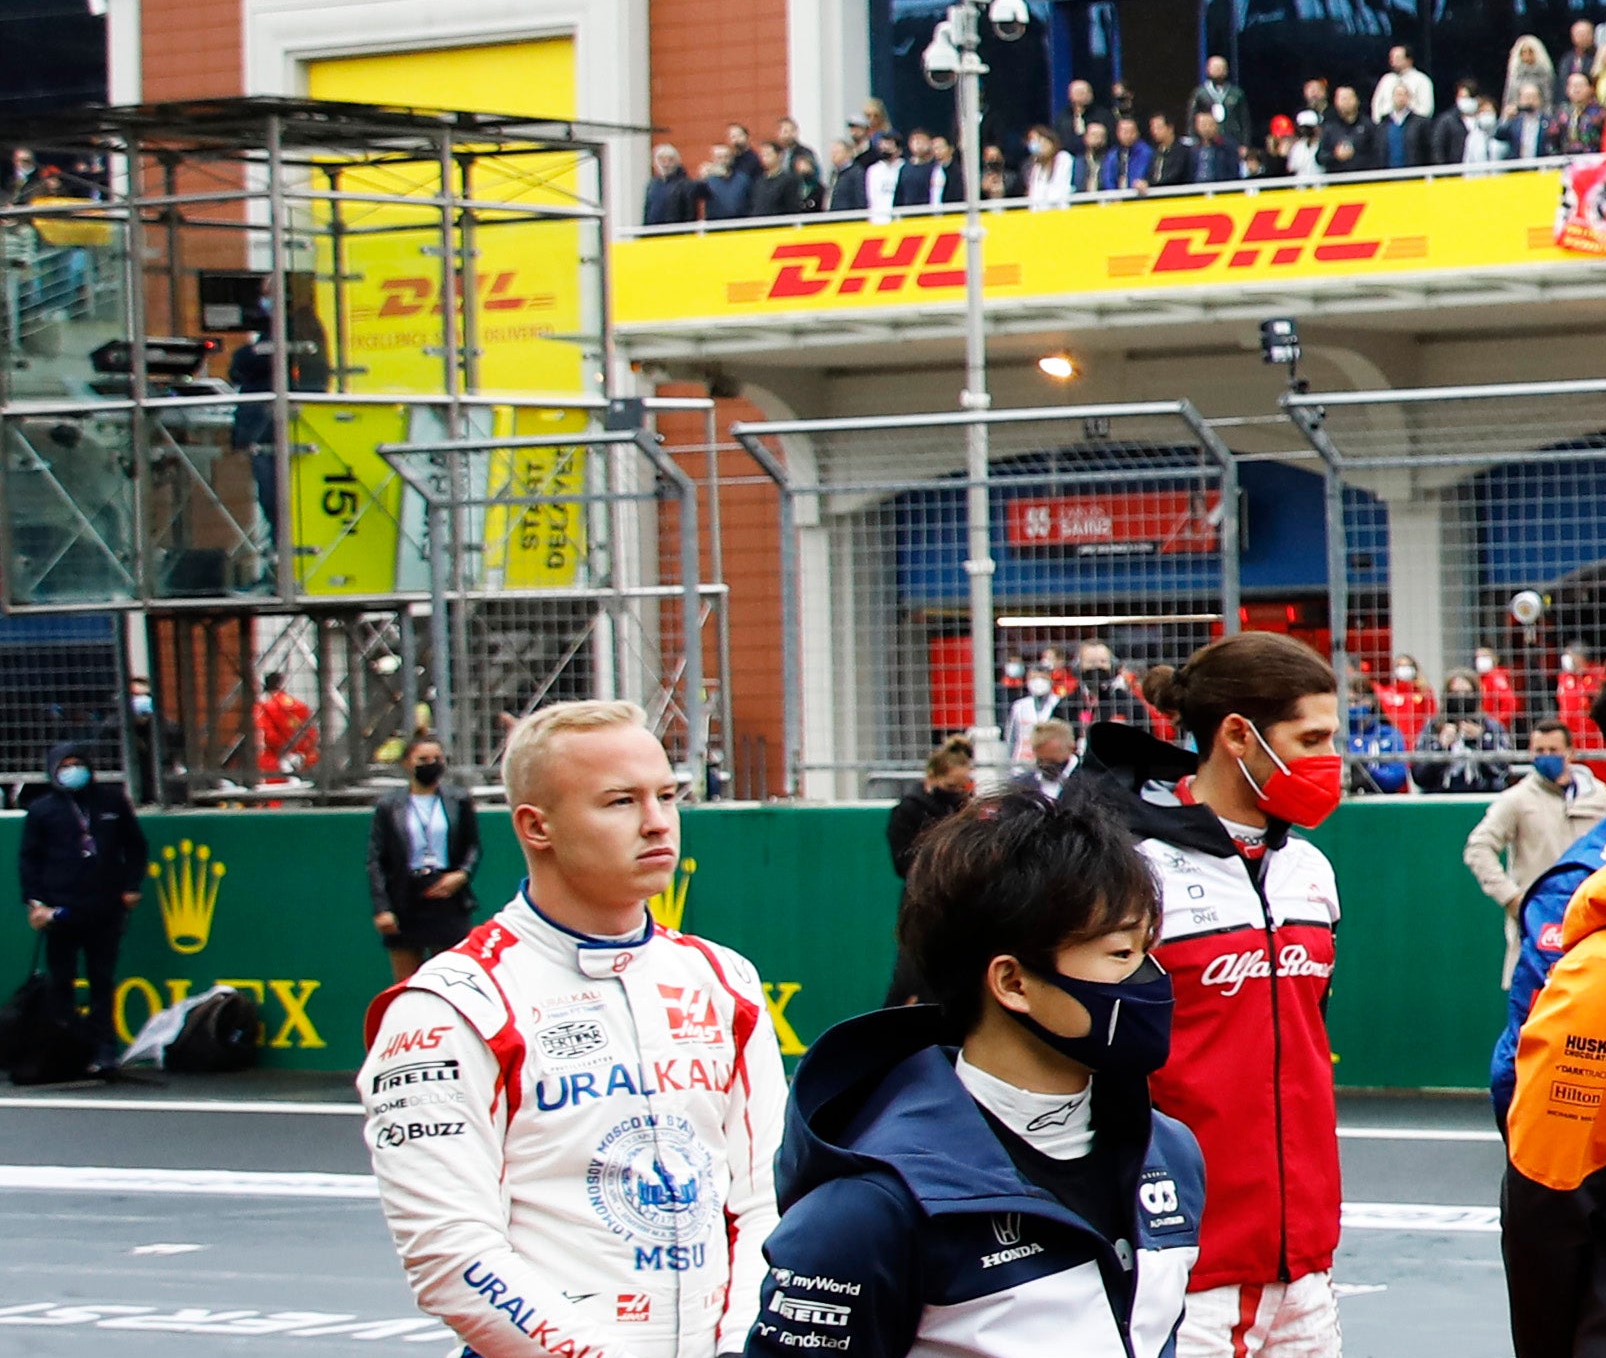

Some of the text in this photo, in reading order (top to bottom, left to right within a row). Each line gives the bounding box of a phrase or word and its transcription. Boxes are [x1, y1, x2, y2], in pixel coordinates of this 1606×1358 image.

[1152, 202, 1382, 273] DHL
[767, 232, 967, 300] DHL
[1201, 944, 1335, 997] Alfa Rom
[380, 1026, 455, 1061] HAAS
[371, 1060, 460, 1095] PIRELLI
[1555, 1085, 1600, 1104] Hilton
[634, 1243, 706, 1272] MSU
[980, 1243, 1044, 1269] HONDA
[792, 1275, 861, 1297] myWorld
[779, 1331, 851, 1351] randstad
